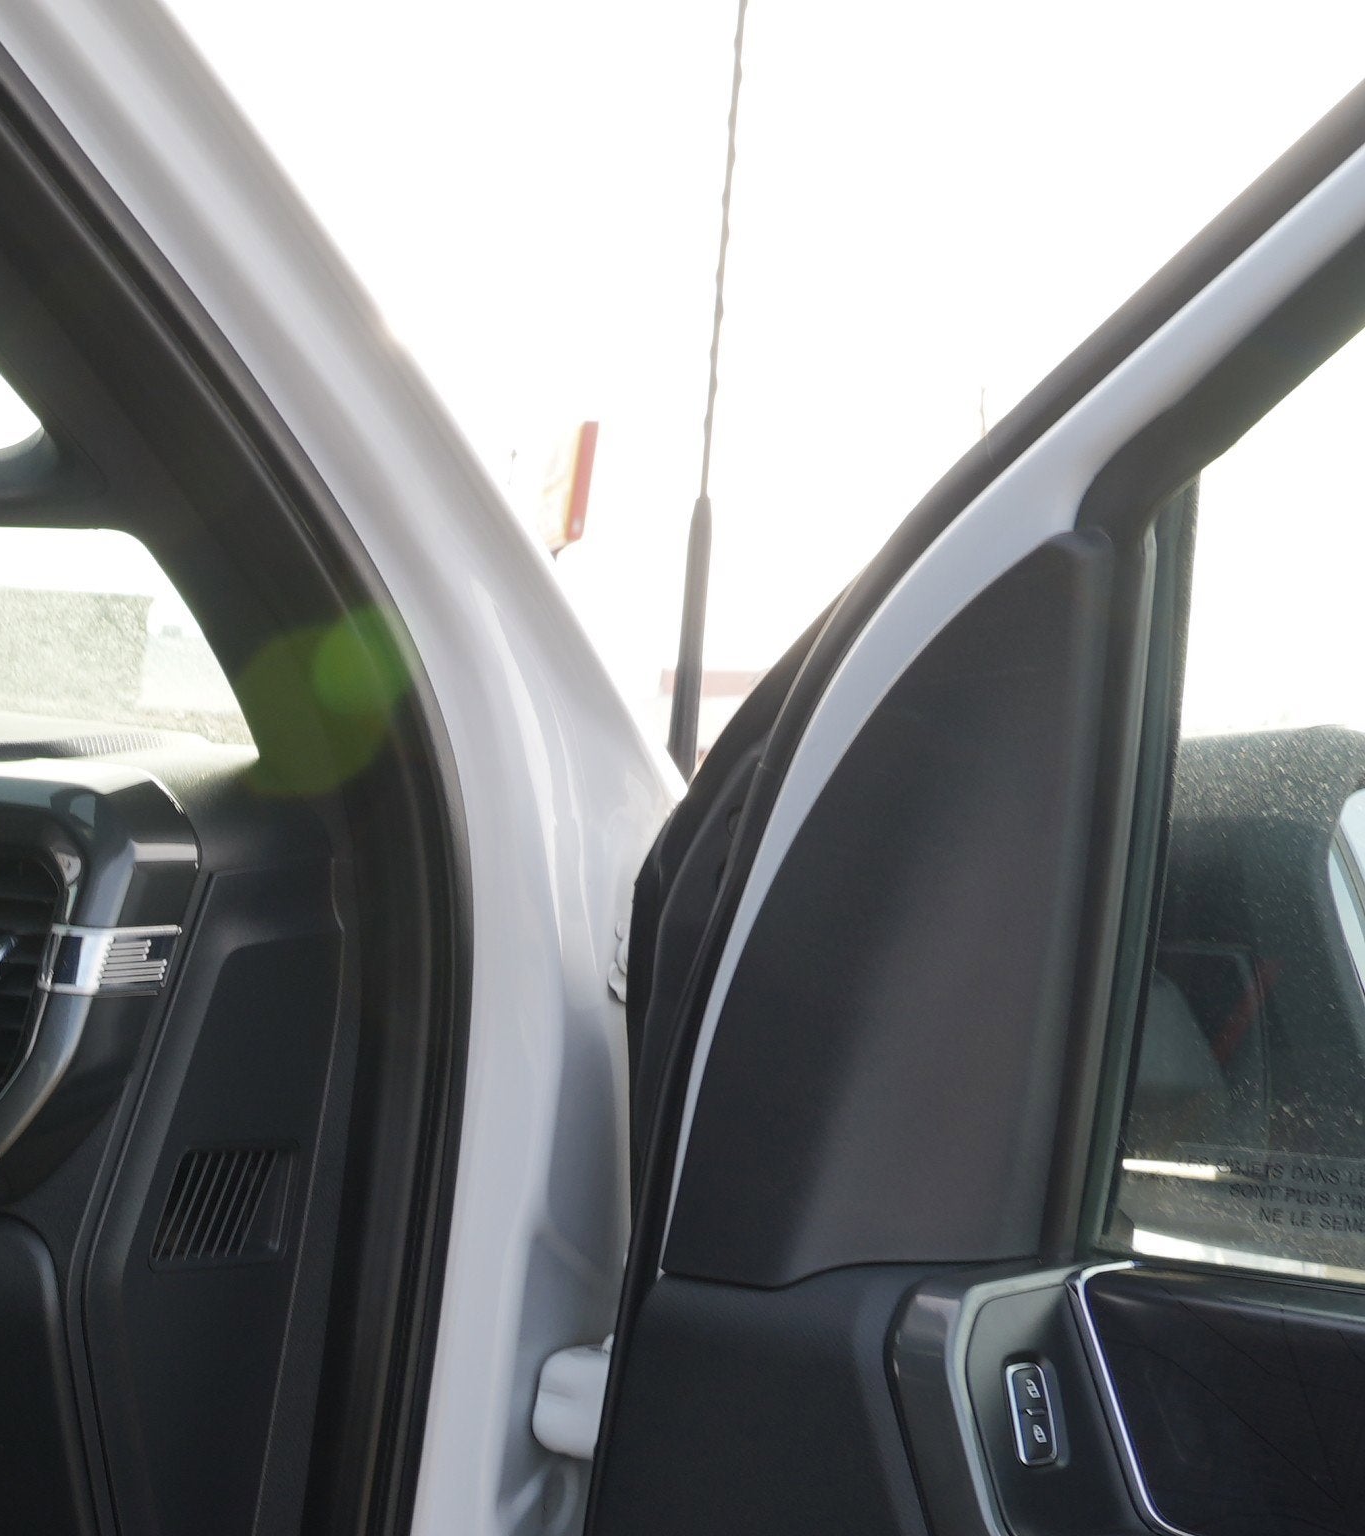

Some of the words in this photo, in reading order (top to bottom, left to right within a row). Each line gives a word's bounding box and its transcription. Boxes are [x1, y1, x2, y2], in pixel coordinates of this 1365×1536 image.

[1291, 1165, 1341, 1186] DANS
[1229, 1183, 1281, 1201] SONT
[1285, 1186, 1331, 1206] PLUS
[1259, 1206, 1284, 1225] NE
[1290, 1211, 1313, 1228] LE
